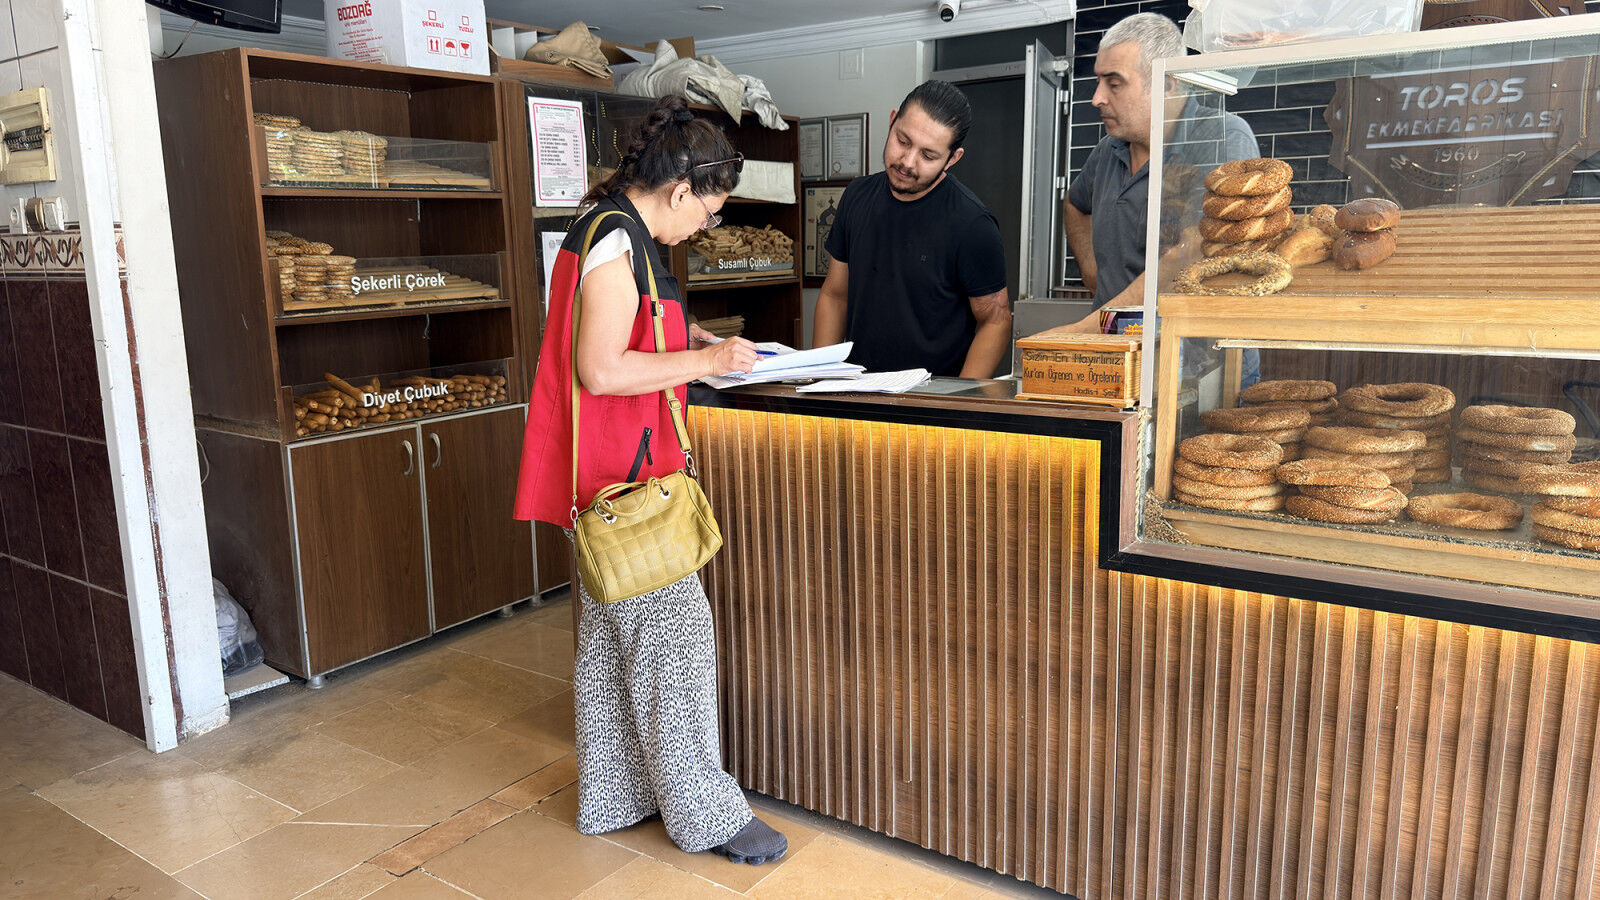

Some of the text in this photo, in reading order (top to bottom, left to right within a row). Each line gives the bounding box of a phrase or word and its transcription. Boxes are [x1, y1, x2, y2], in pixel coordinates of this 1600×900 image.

[1400, 77, 1528, 111] TOROS
[1435, 147, 1480, 163] 1960
[718, 256, 772, 270] Susamlı Çubuk
[351, 273, 446, 295] Şekerli Çörek
[1026, 351, 1048, 361] Sizin
[1056, 352, 1068, 362] En
[1048, 365, 1073, 383] Öğrenen
[1076, 372, 1085, 381] ve
[363, 381, 449, 408] Diyet Çubuk
